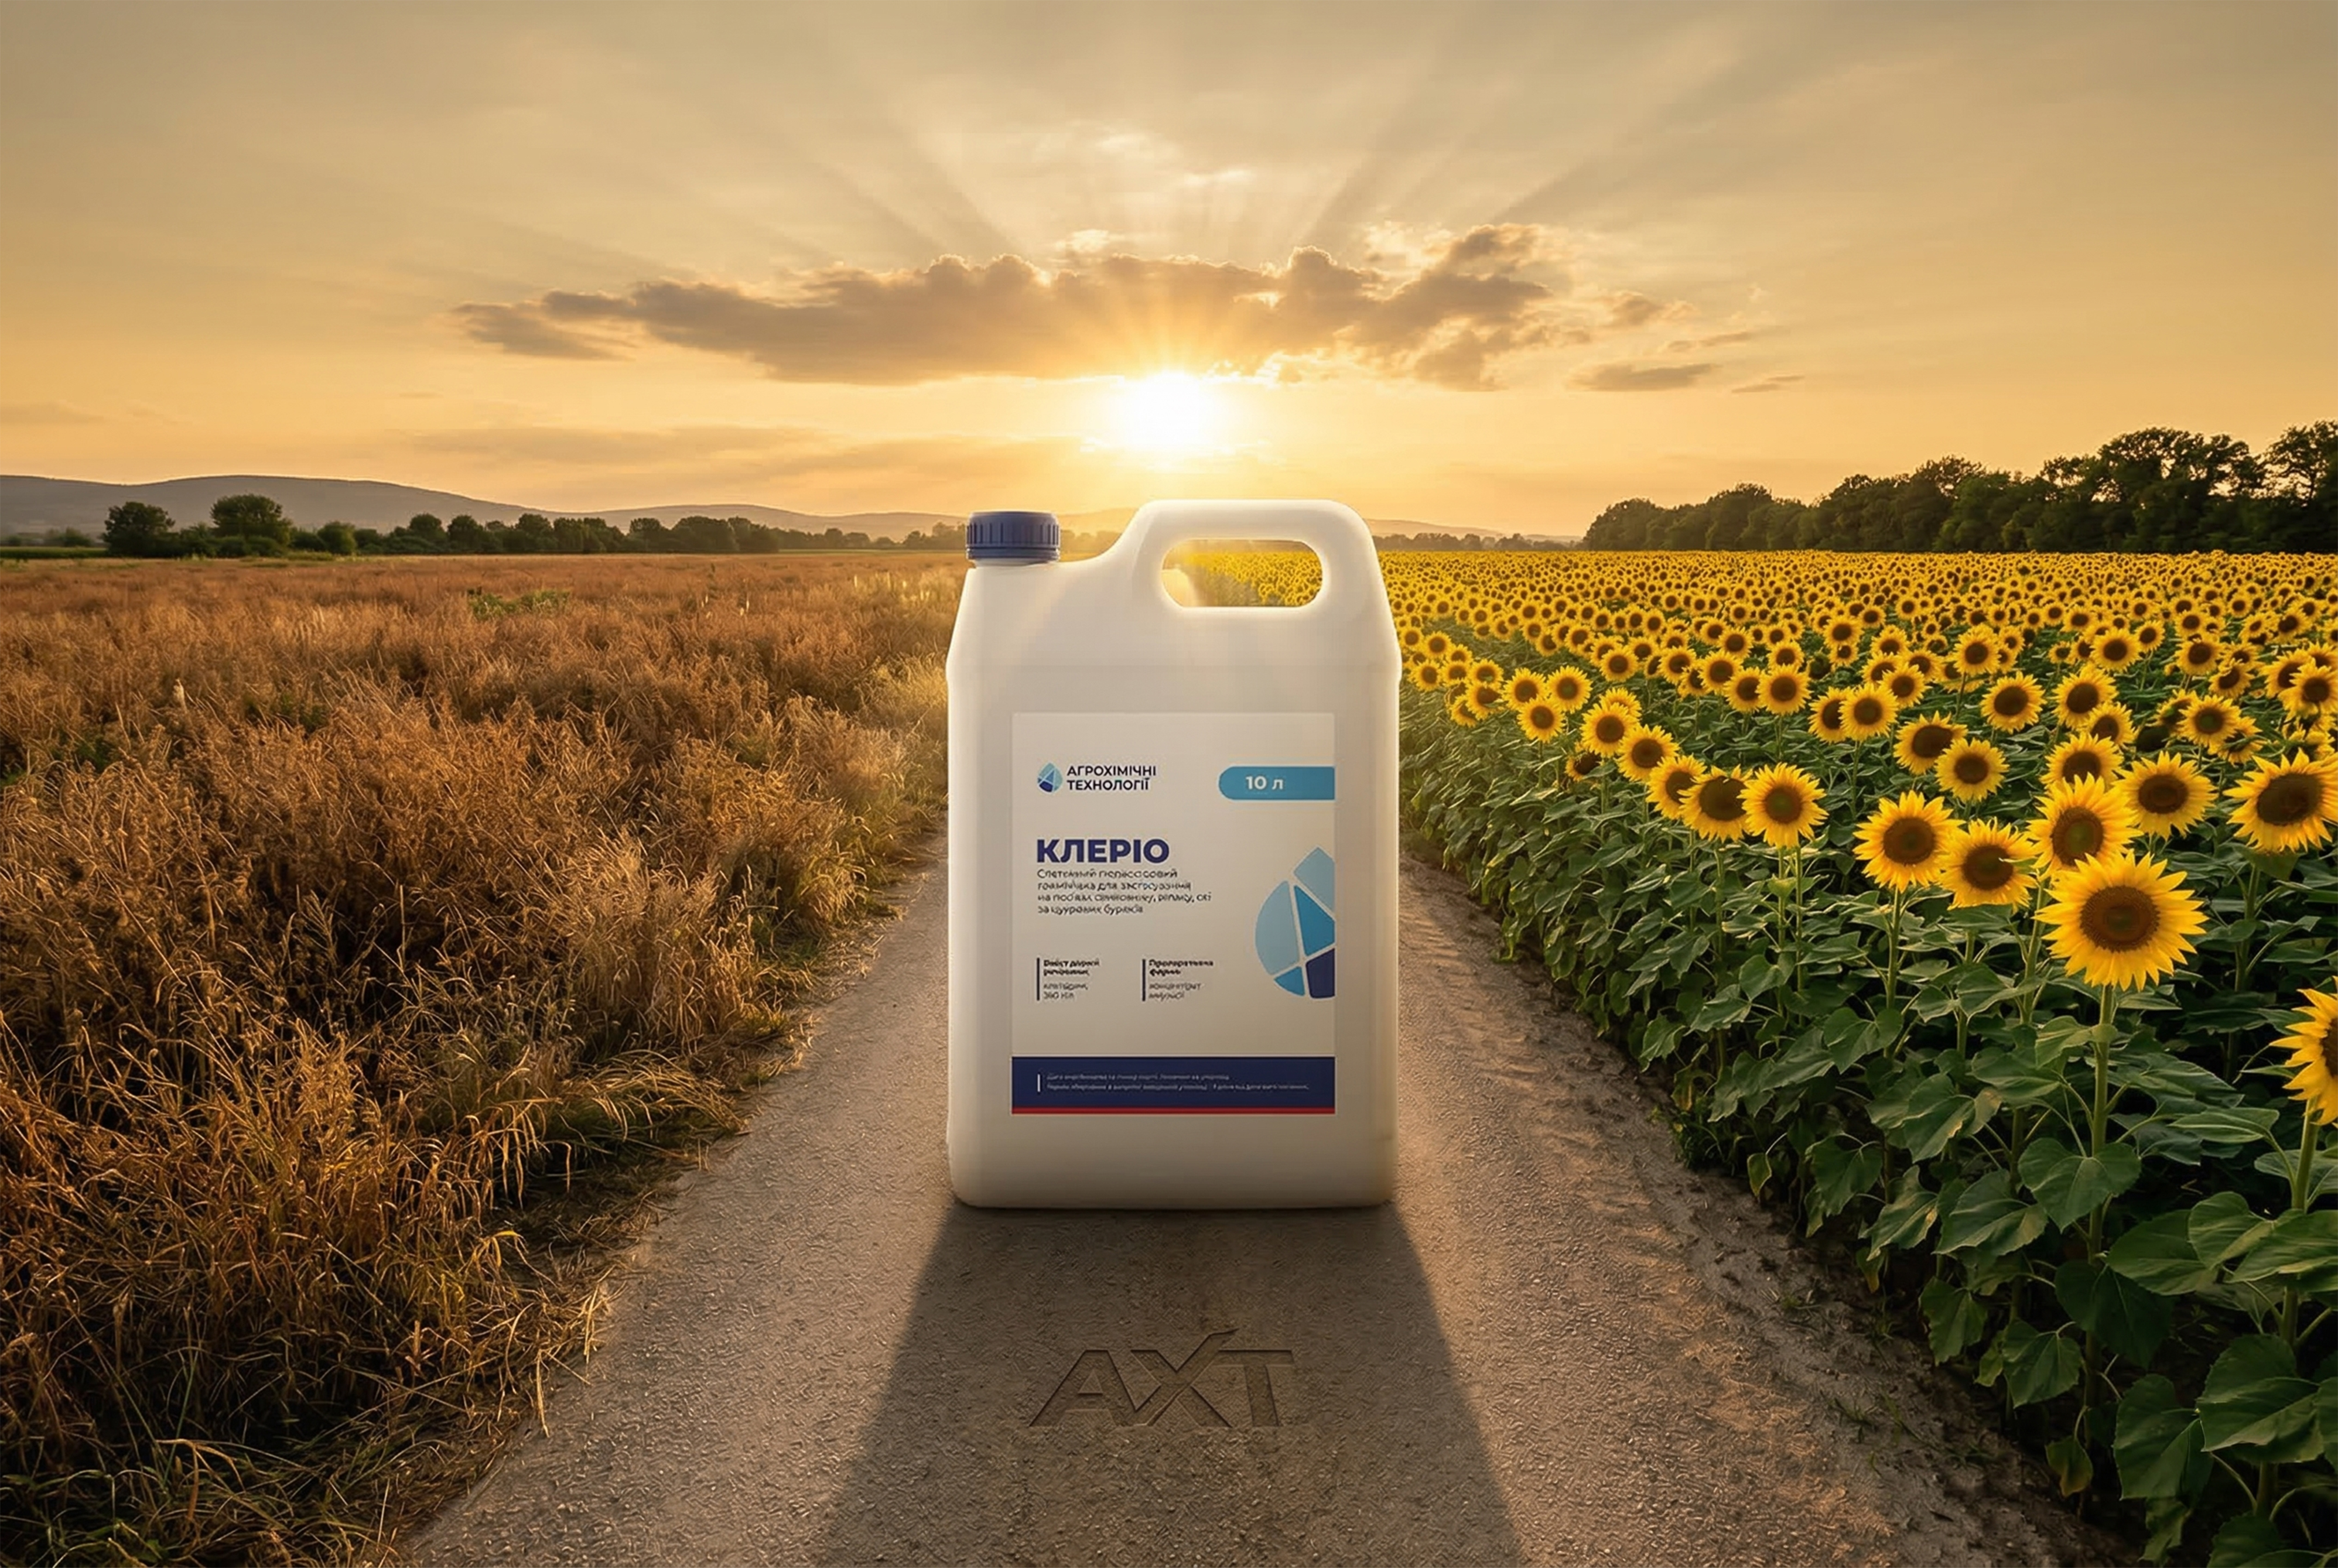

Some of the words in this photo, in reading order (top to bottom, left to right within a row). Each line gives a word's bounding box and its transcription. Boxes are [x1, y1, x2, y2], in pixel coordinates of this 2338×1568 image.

[1067, 765, 1156, 776] АГРОХІМІЧНІ
[1067, 778, 1150, 790] ТЕХНОЛОГІЇ
[1246, 776, 1267, 790] 10
[1271, 779, 1283, 790] л
[1037, 838, 1170, 864] КЛЕРІО
[1028, 1328, 1295, 1427] АХТ
